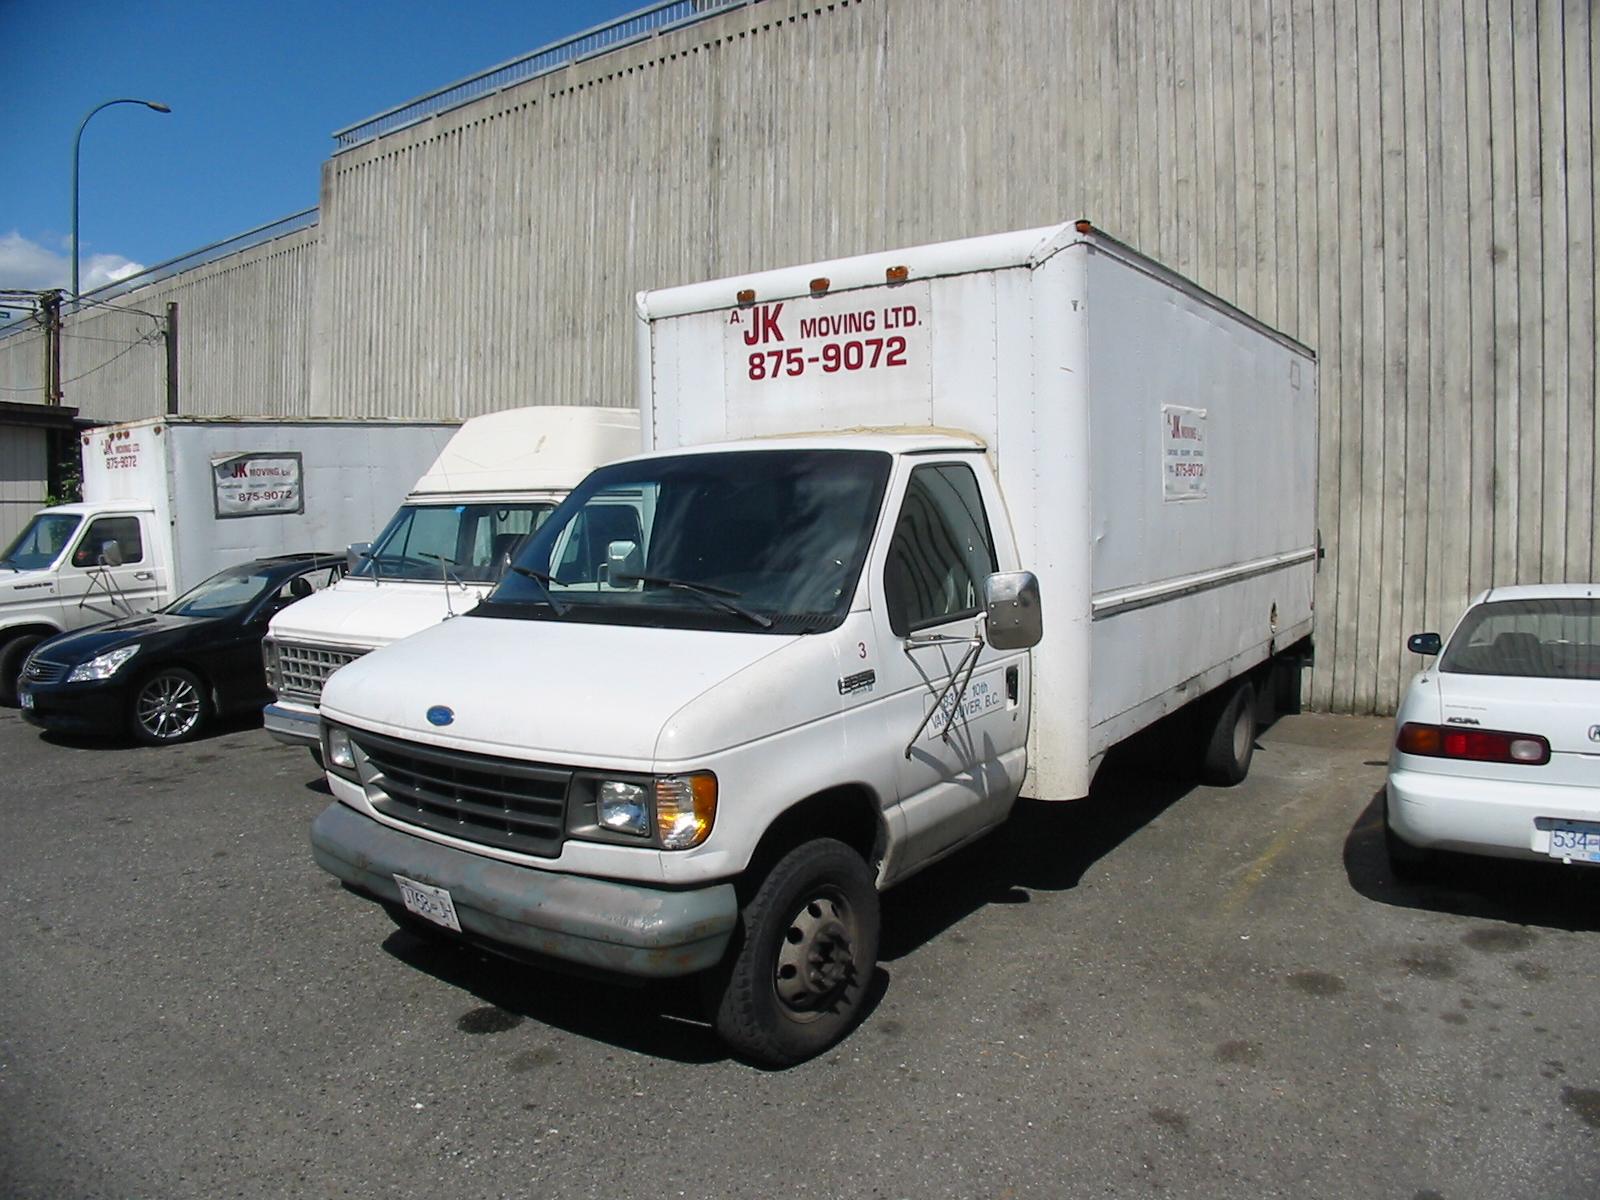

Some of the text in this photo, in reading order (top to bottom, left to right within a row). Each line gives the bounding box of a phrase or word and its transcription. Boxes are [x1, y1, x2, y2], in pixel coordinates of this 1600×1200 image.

[743, 303, 785, 346] JK
[800, 310, 876, 339] MOVING
[884, 305, 922, 330] LTD.
[748, 336, 907, 381] 875-9072
[105, 455, 138, 469] 875-9072
[231, 462, 248, 478] JK
[249, 467, 280, 477] MOVING
[238, 490, 292, 502] 875-9072
[858, 641, 867, 660] 3
